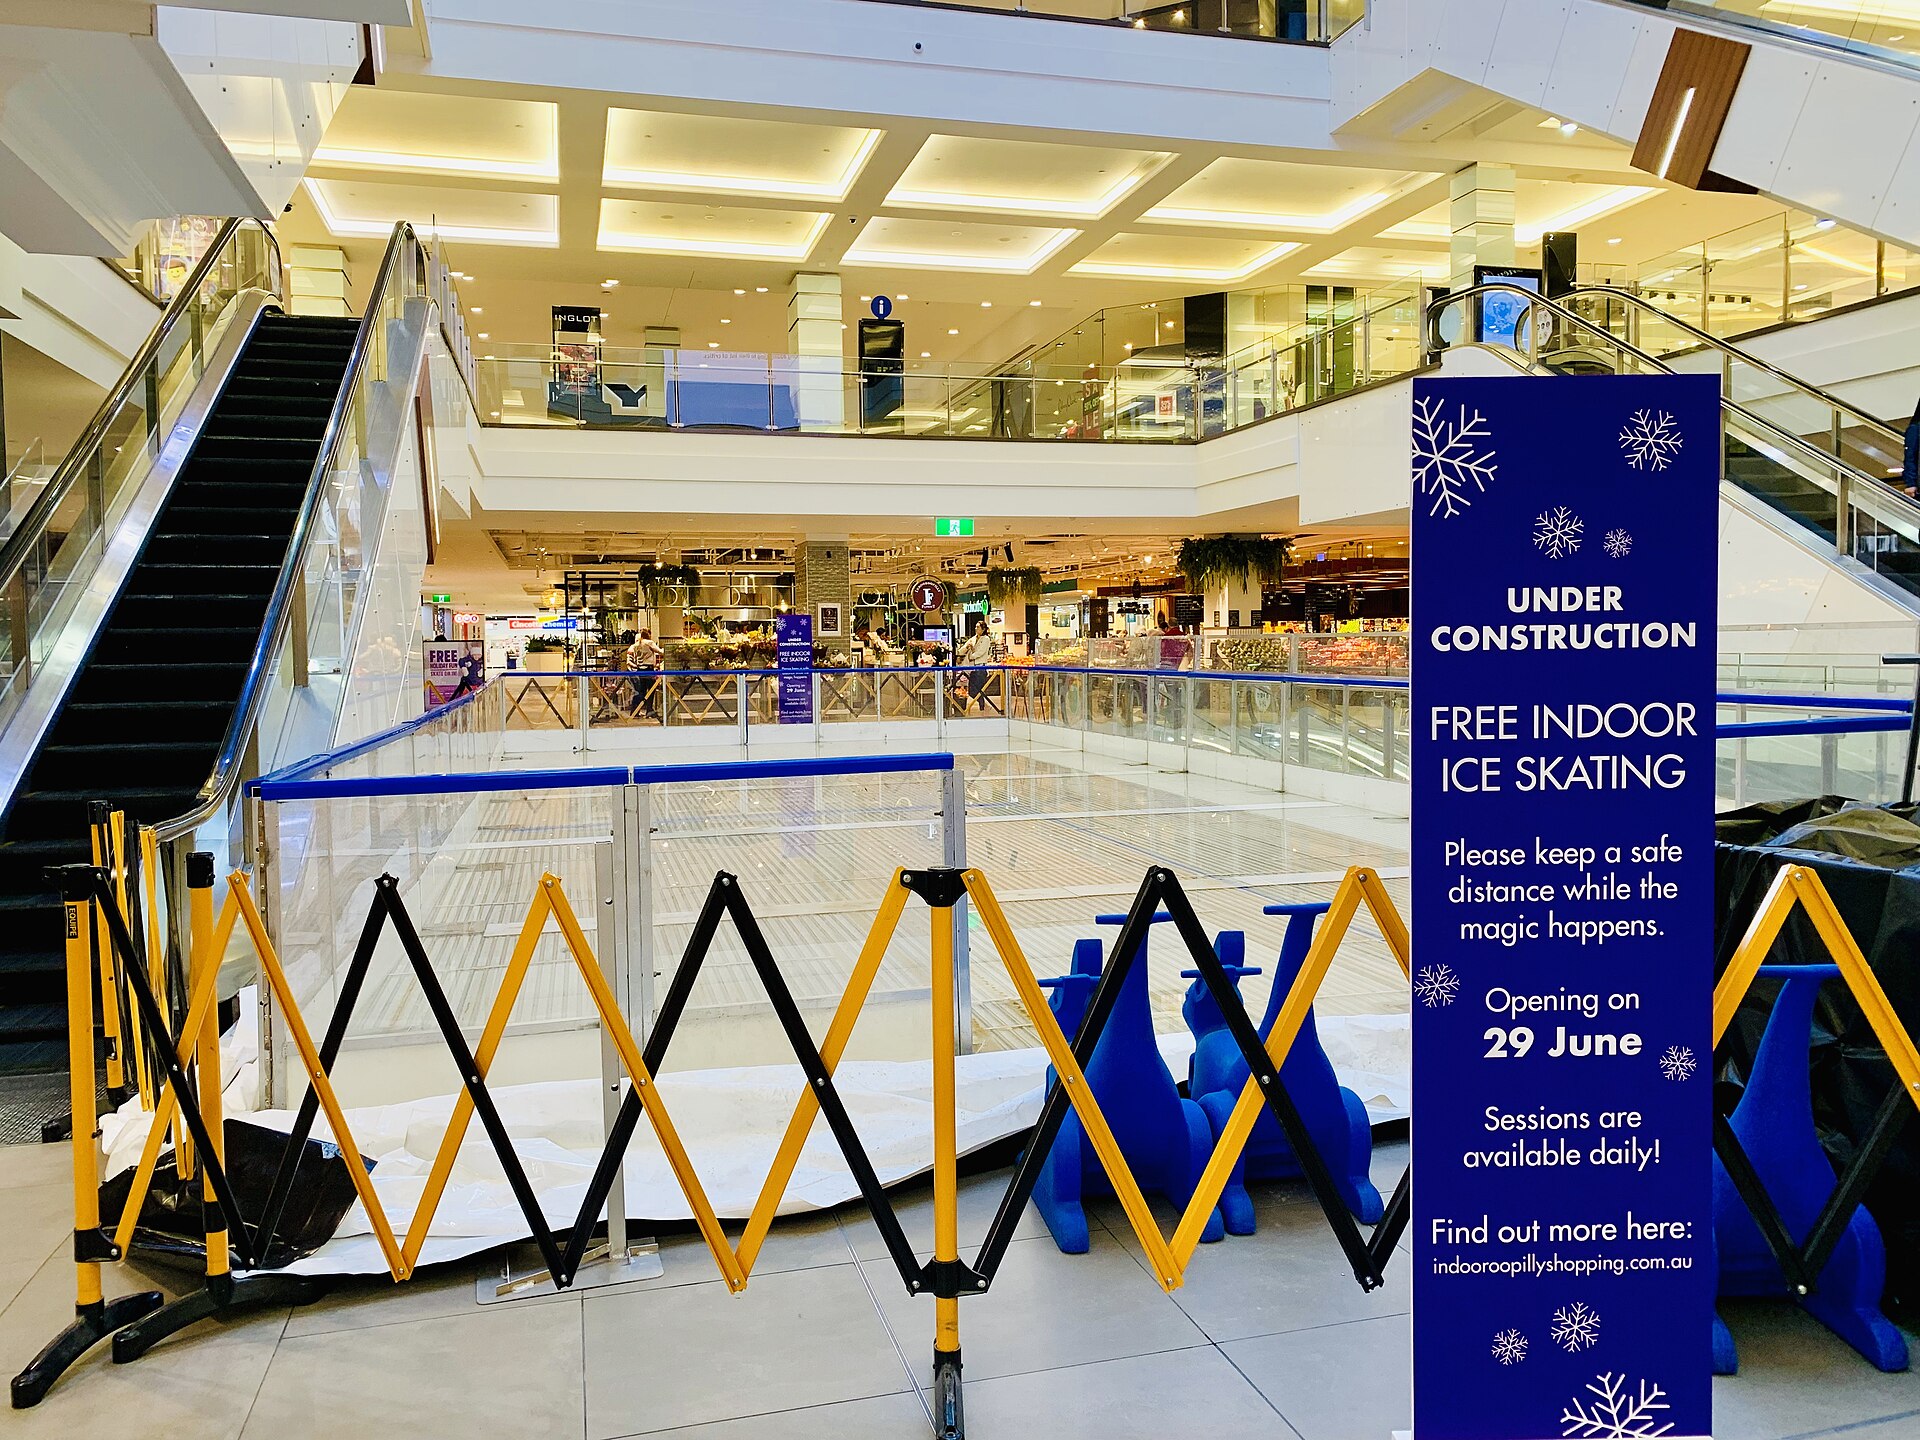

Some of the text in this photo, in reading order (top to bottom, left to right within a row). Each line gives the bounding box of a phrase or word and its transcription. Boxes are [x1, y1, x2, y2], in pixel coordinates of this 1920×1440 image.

[554, 314, 598, 323] INGLOT
[1508, 585, 1624, 613] UNDER
[511, 620, 543, 628] Cincott
[1431, 622, 1696, 652] CONSTRUCTION
[429, 650, 458, 663] FREE
[1432, 702, 1697, 741] FREE INDOOR
[1443, 754, 1686, 792] ICE SKATING
[1445, 834, 1683, 872] Please keep a safe
[1448, 871, 1678, 903] distance while the
[69, 907, 77, 936] EQUIPE
[1460, 910, 1665, 947] magic happens.
[1485, 986, 1640, 1020] Opening on
[1483, 1026, 1643, 1058] 29 June
[1484, 1105, 1642, 1131] Sessions are
[1463, 1136, 1660, 1171] available daily!
[1432, 1211, 1692, 1244] Find out more here:
[1433, 1252, 1692, 1277] indooroopillyshopping.com.au
